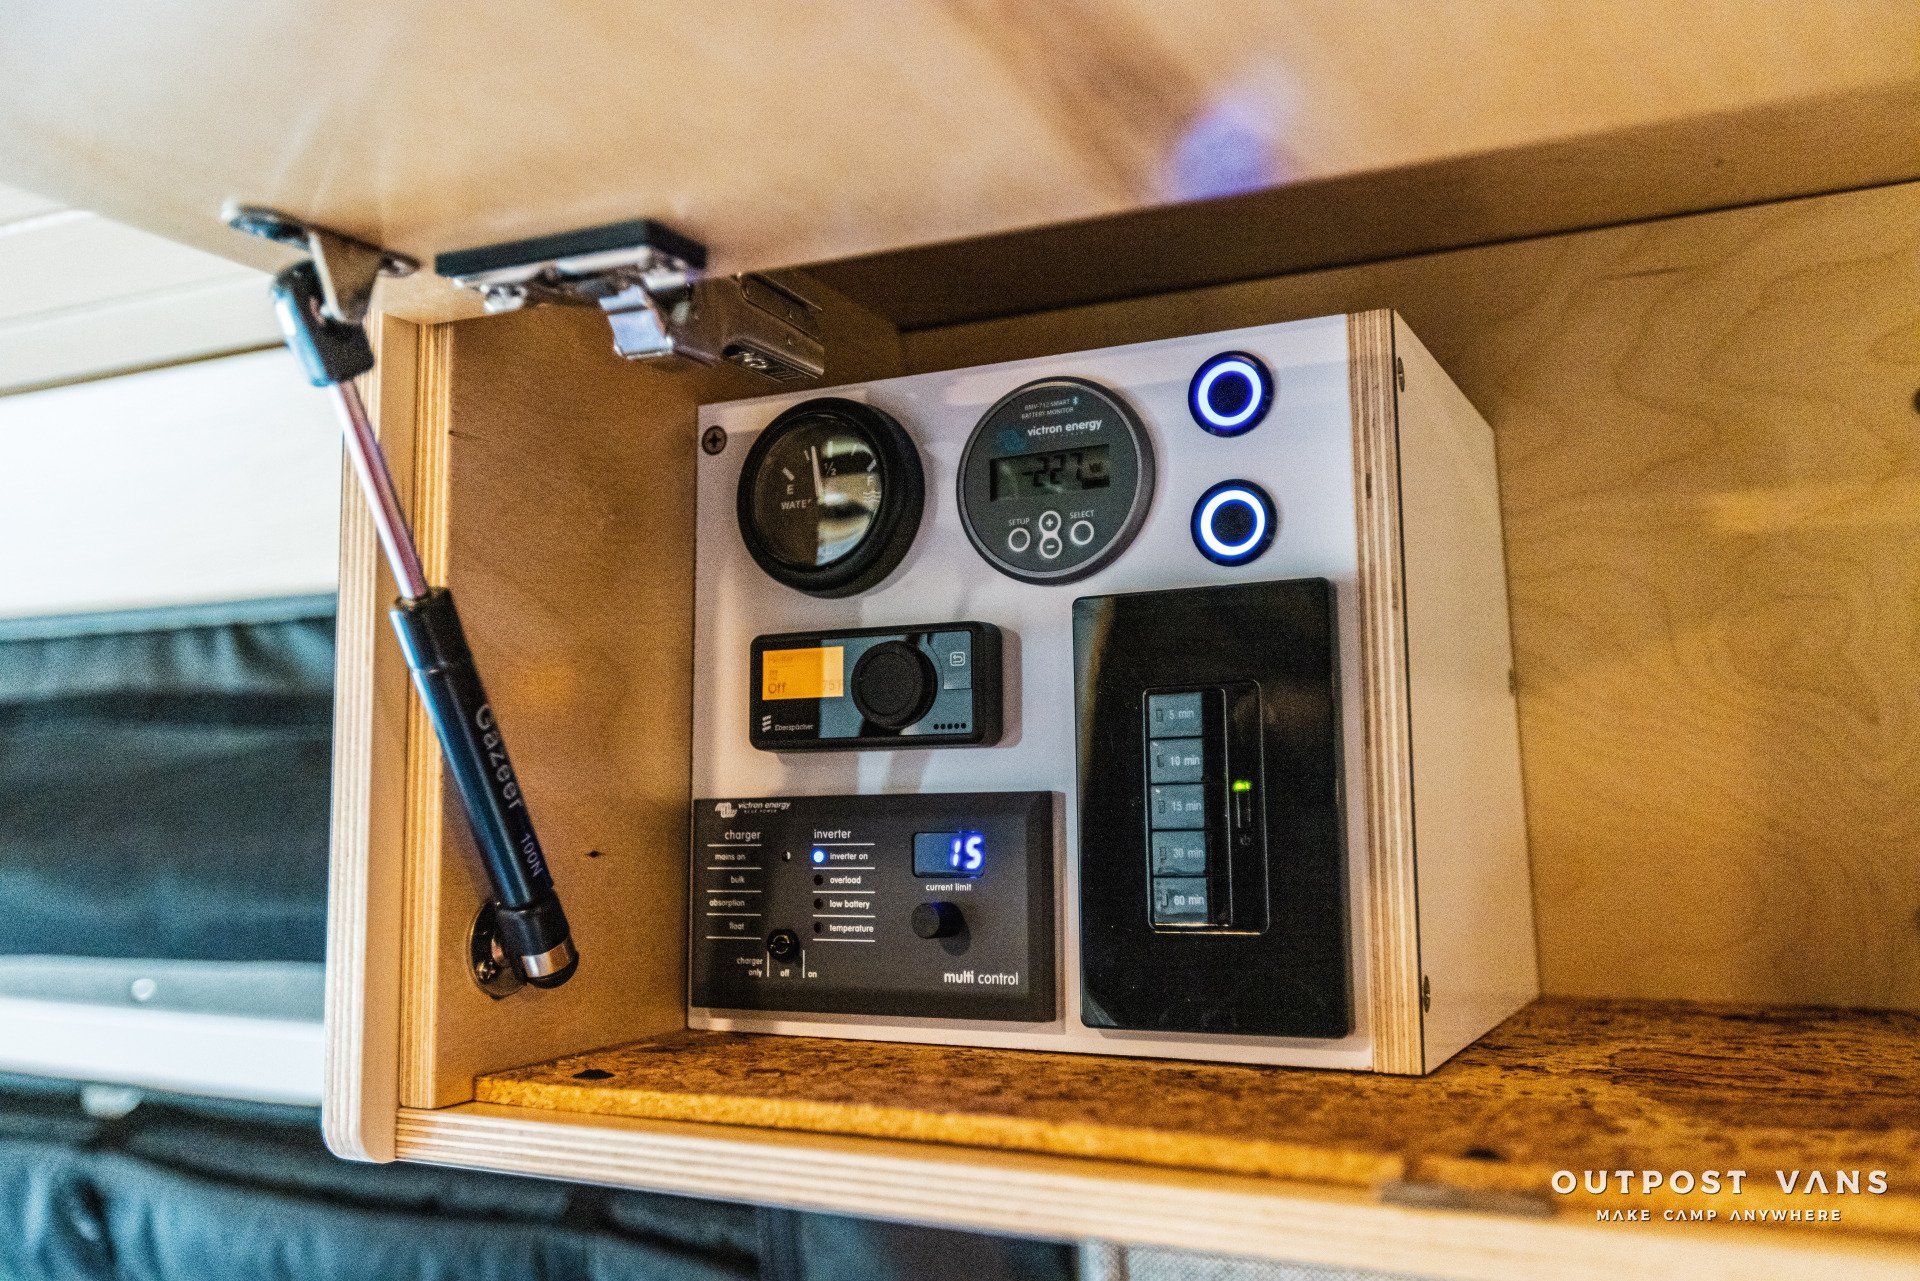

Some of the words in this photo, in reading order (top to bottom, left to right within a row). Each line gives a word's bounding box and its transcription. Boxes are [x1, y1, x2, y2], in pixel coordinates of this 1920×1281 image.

[1046, 407, 1074, 416] MONITOR
[1027, 424, 1063, 437] victron
[1065, 419, 1103, 431] energy
[786, 483, 795, 496] E
[1069, 509, 1095, 519] SELECT
[1008, 518, 1030, 527] SETUP
[768, 682, 786, 694] Off
[1178, 710, 1194, 719] min
[475, 703, 523, 809] Gazeer
[1170, 756, 1180, 765] 10
[1184, 756, 1200, 765] min
[738, 801, 763, 809] victron
[764, 801, 791, 810] energy
[1171, 802, 1183, 811] 15
[1186, 801, 1201, 811] min
[724, 829, 761, 842] charger
[813, 829, 851, 839] inverter
[520, 833, 544, 878] 100N
[714, 852, 735, 860] mains
[829, 852, 857, 860] inverter
[952, 835, 982, 870] 15
[1173, 848, 1184, 858] 30
[1187, 848, 1203, 858] min
[730, 875, 745, 884] bulk
[829, 876, 861, 884] overload
[925, 883, 953, 892] current
[955, 883, 972, 892] limit
[709, 899, 745, 908] absorption
[829, 900, 843, 908] low
[844, 900, 870, 909] battery
[1188, 895, 1204, 905] min
[729, 922, 744, 930] float
[829, 924, 874, 934] temperature
[736, 957, 763, 966] charger
[748, 969, 763, 978] only
[780, 969, 790, 977] off
[943, 970, 974, 984] multi
[977, 972, 1019, 986] control
